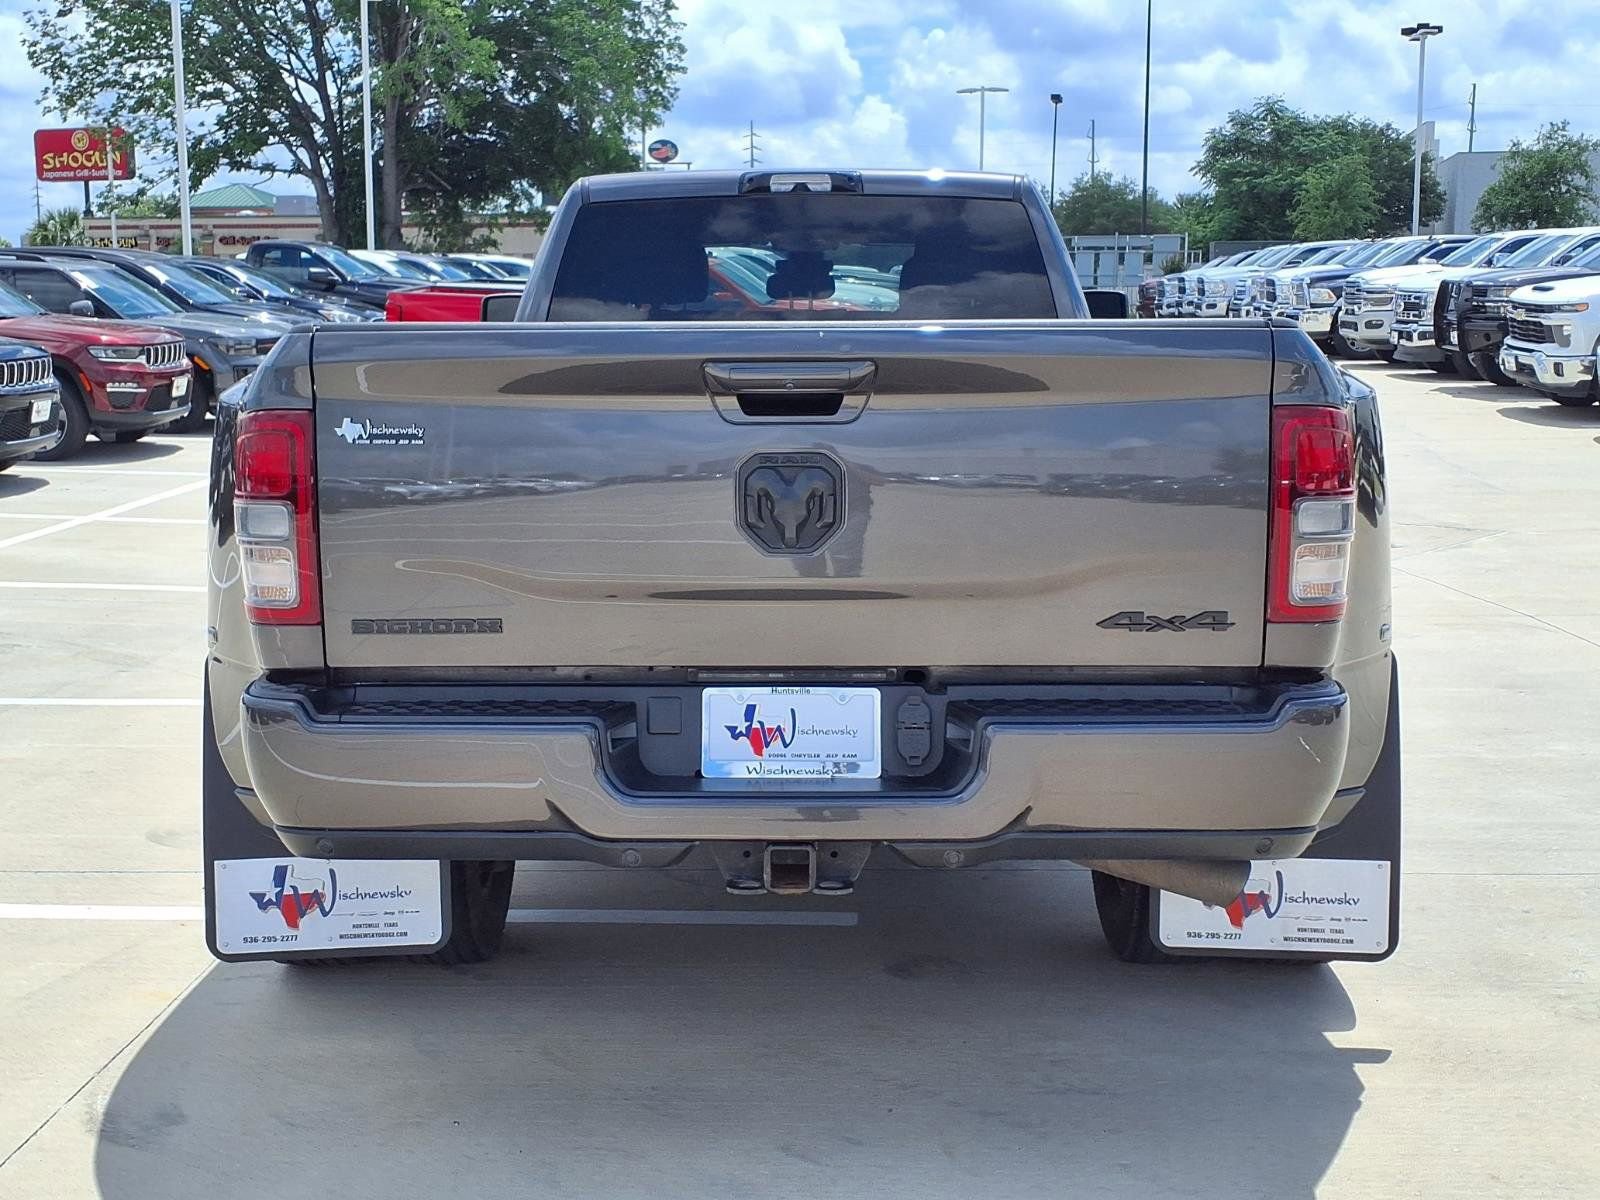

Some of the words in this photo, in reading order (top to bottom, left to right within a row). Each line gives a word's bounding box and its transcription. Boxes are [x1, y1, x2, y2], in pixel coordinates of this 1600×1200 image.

[42, 150, 121, 170] SHOGUN
[351, 618, 503, 634] BIGHORN
[771, 687, 811, 695] Huntsville
[757, 707, 858, 749] Wischnewsky
[746, 762, 838, 782] Wischnewsky
[242, 934, 298, 944] 936-295-2277
[1186, 931, 1242, 940] 936-295-2277
